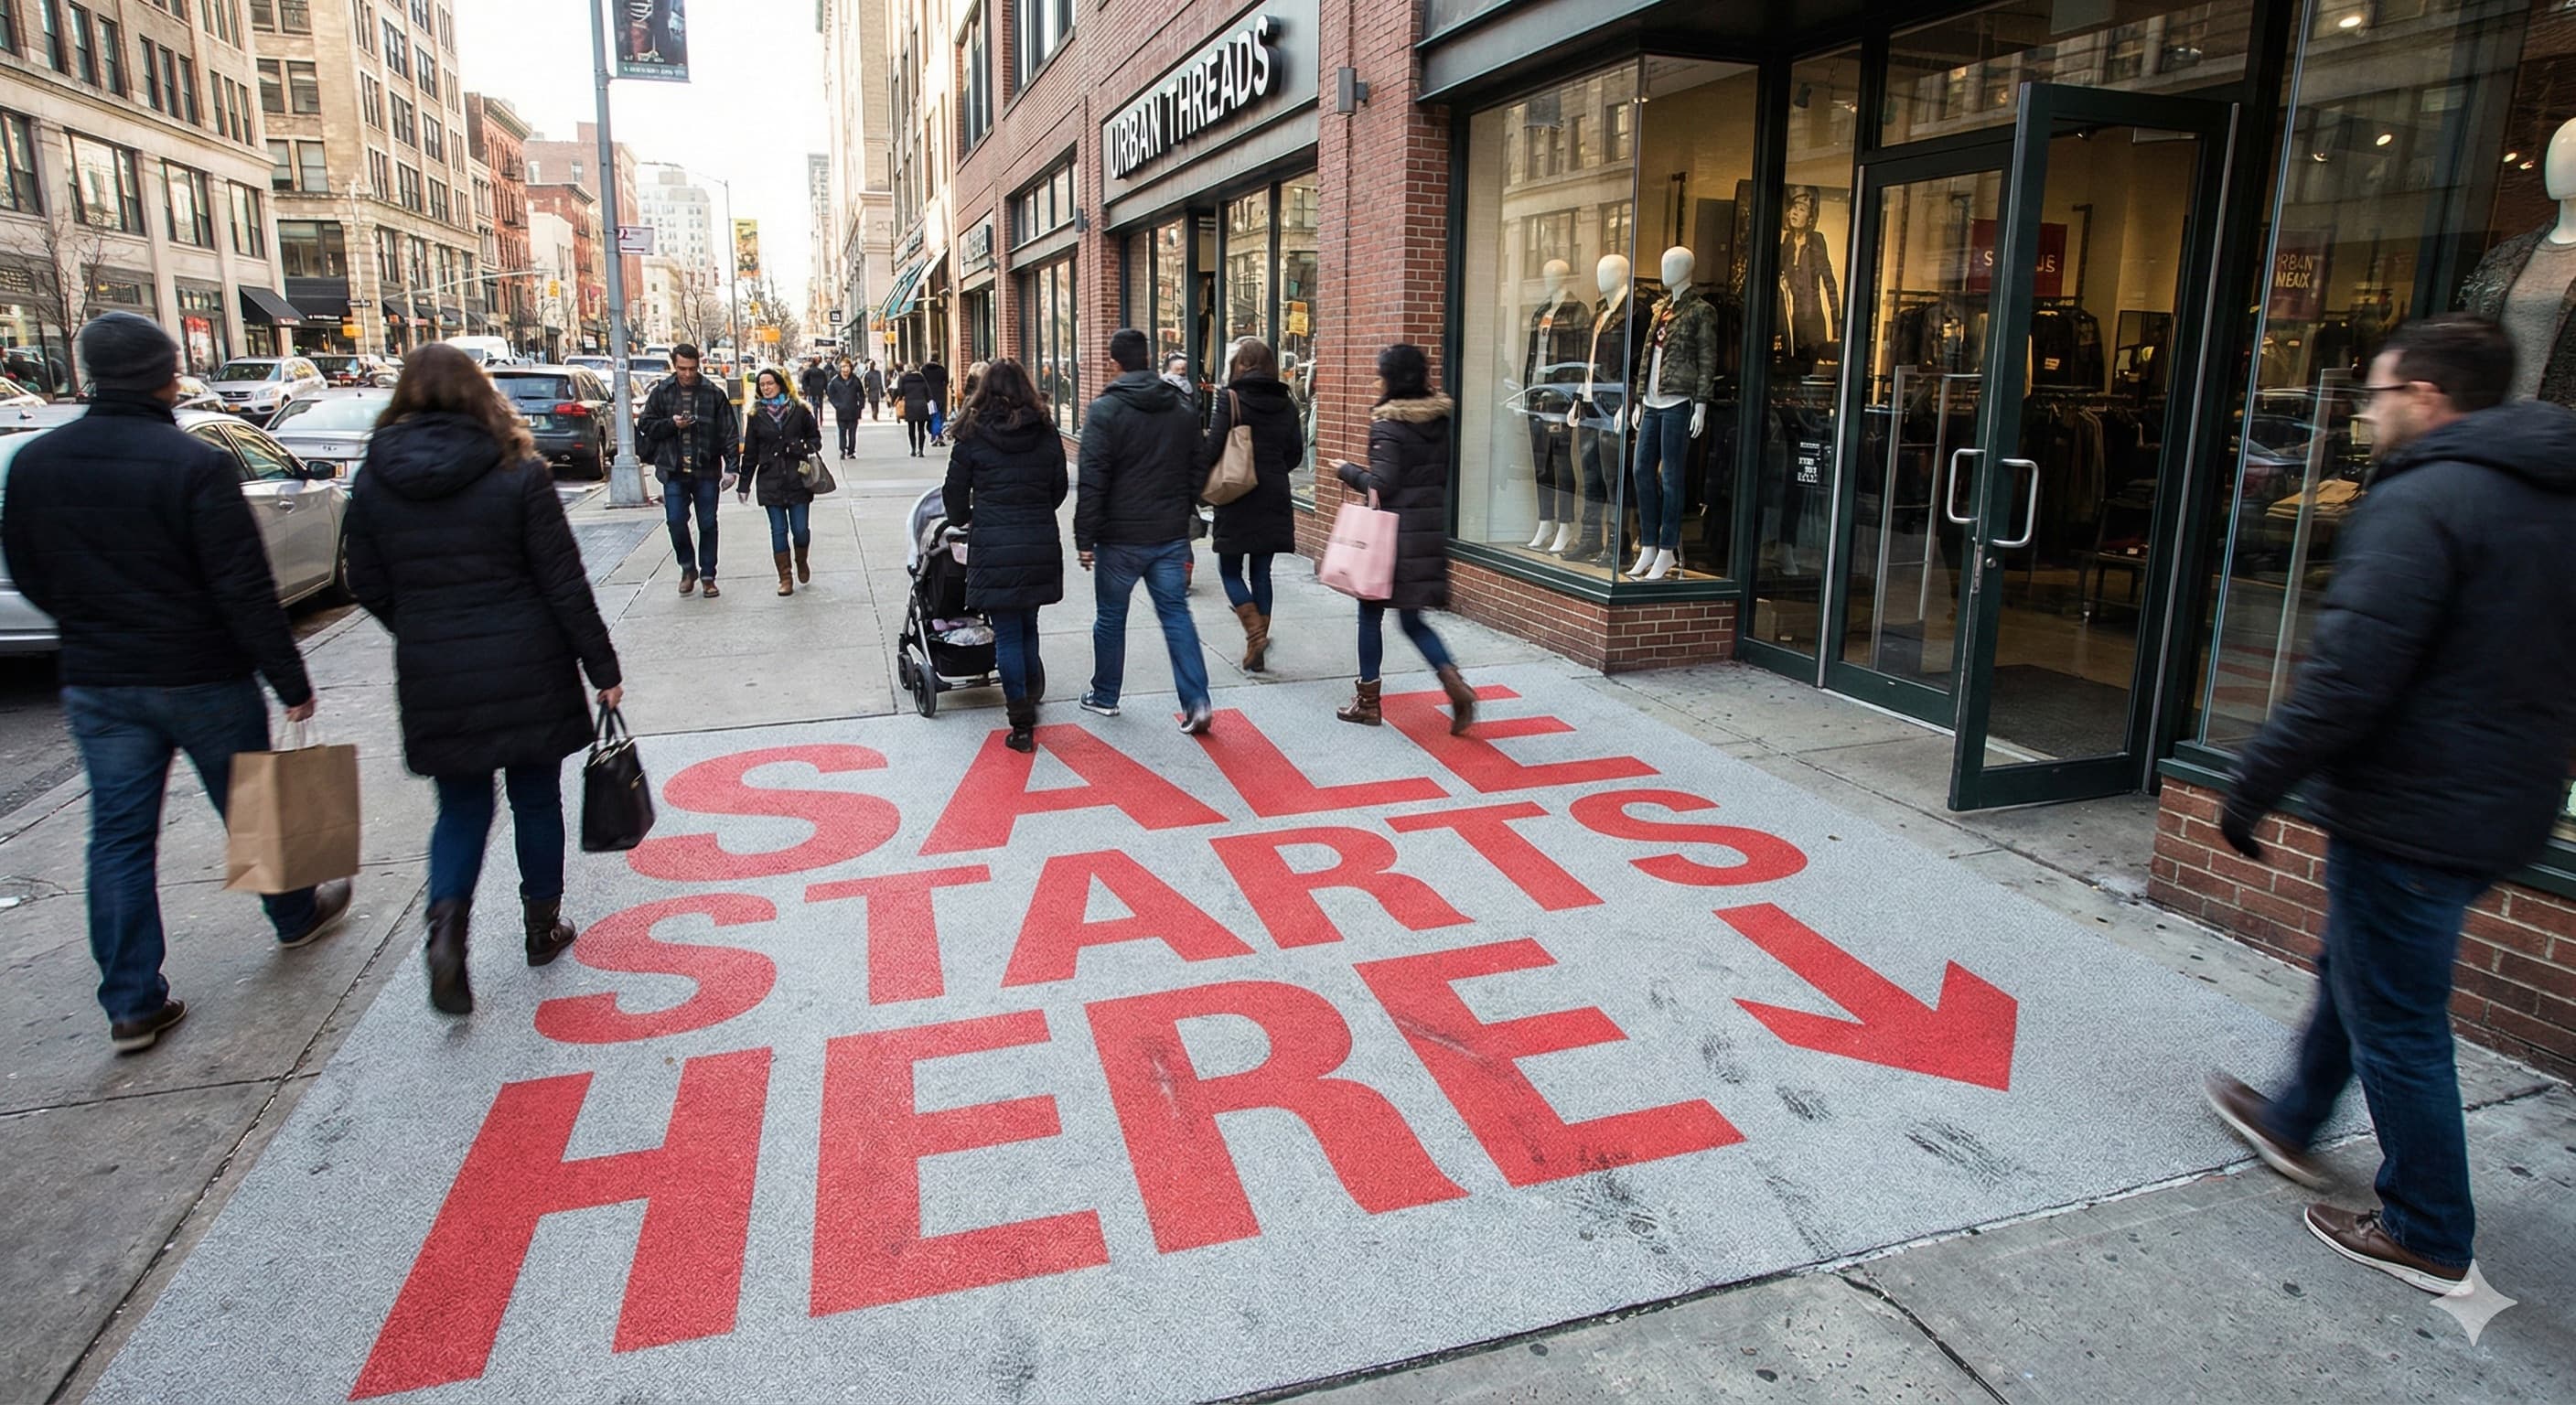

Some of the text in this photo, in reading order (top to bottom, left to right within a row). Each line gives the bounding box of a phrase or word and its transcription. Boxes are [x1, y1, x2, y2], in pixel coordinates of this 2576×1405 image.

[1111, 15, 1272, 179] URBAN THREADS
[627, 685, 1658, 881] SALE
[535, 789, 1807, 1044] STARTS
[349, 938, 1744, 1400] HERE
